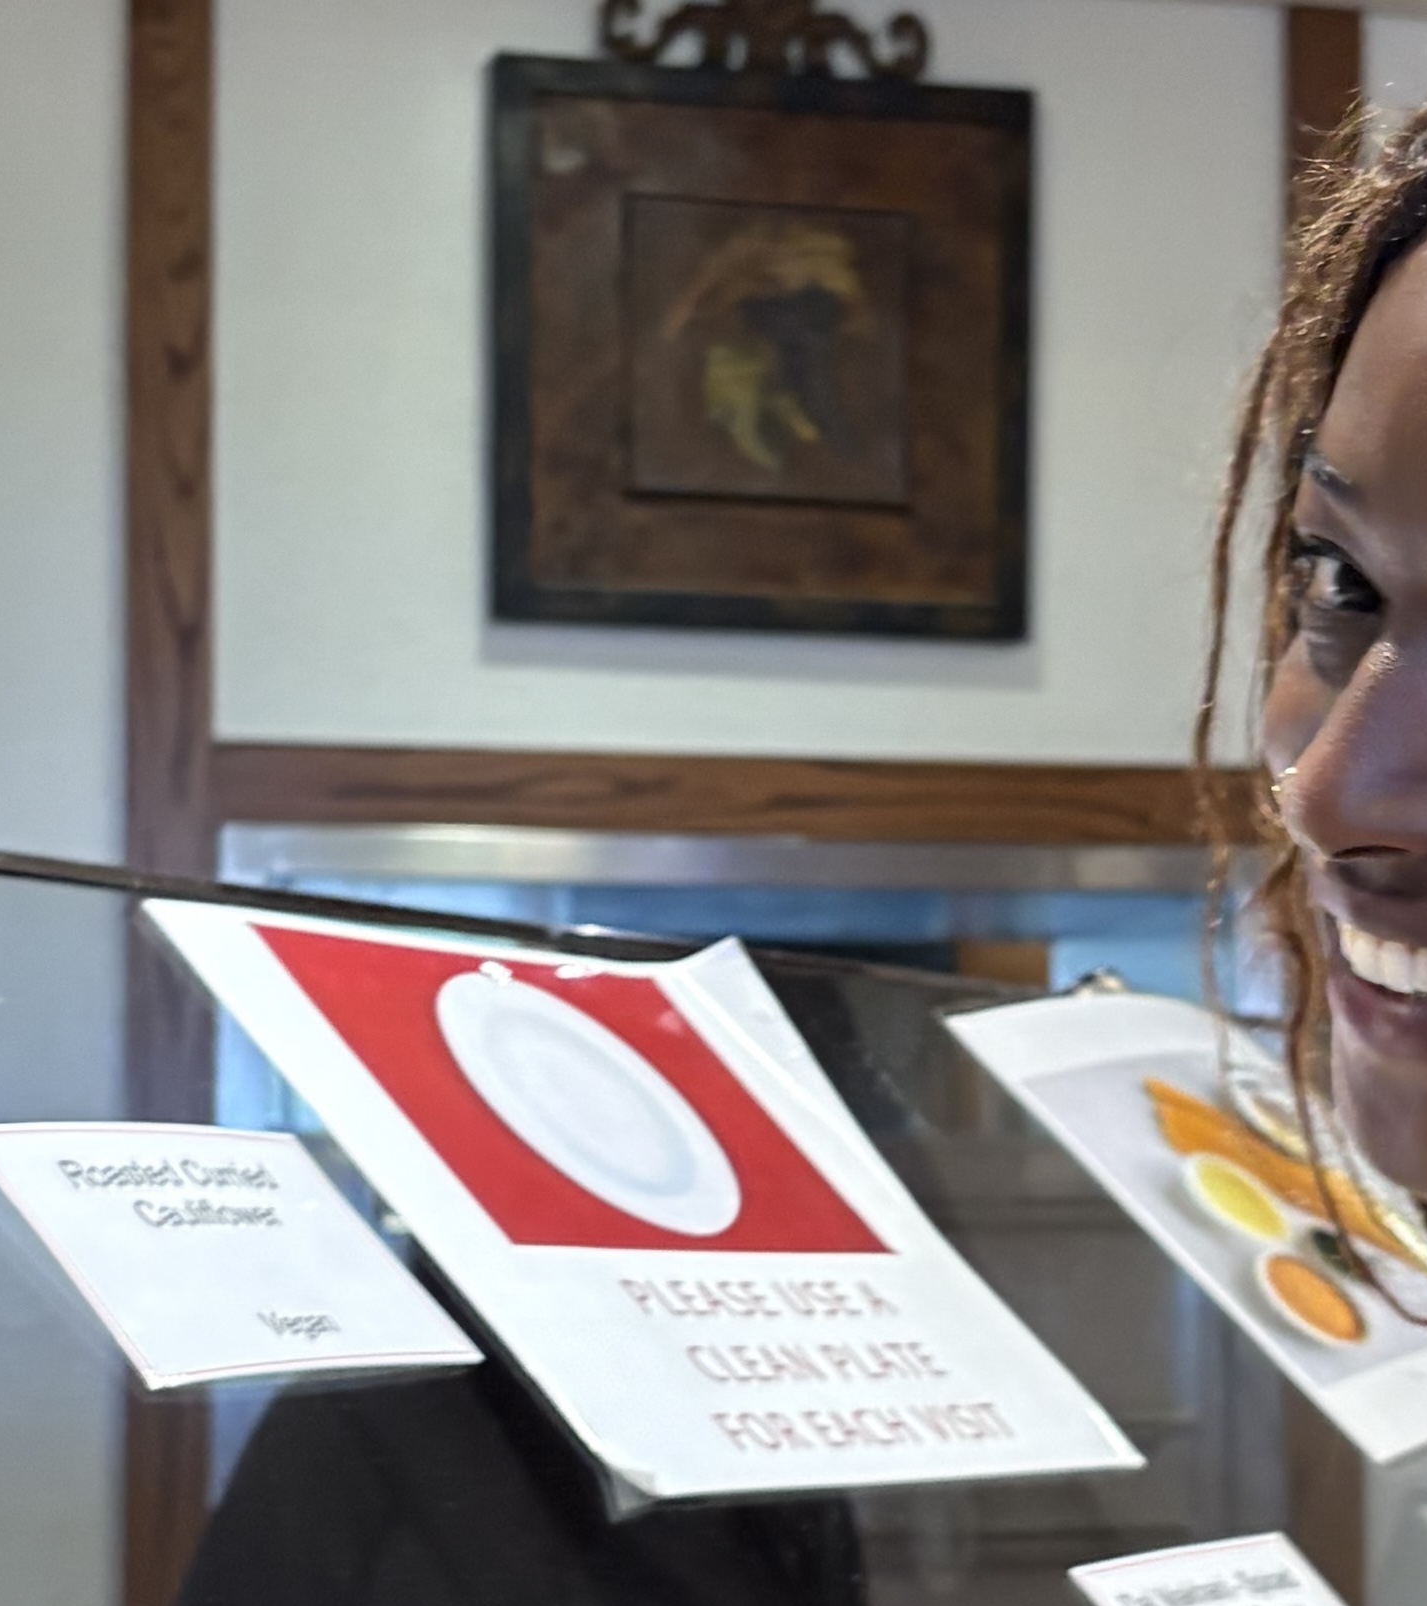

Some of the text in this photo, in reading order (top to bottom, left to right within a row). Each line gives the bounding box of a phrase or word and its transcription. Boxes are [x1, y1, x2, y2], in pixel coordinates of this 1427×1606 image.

[57, 1157, 279, 1190] Roasted Curried
[132, 1199, 281, 1228] Cauliflower
[618, 1278, 899, 1317] PLEASE USE A
[257, 1311, 341, 1341] Vegan
[685, 1341, 950, 1384] CLEAN PLATE
[710, 1401, 1015, 1453] FOR EACH VISIT
